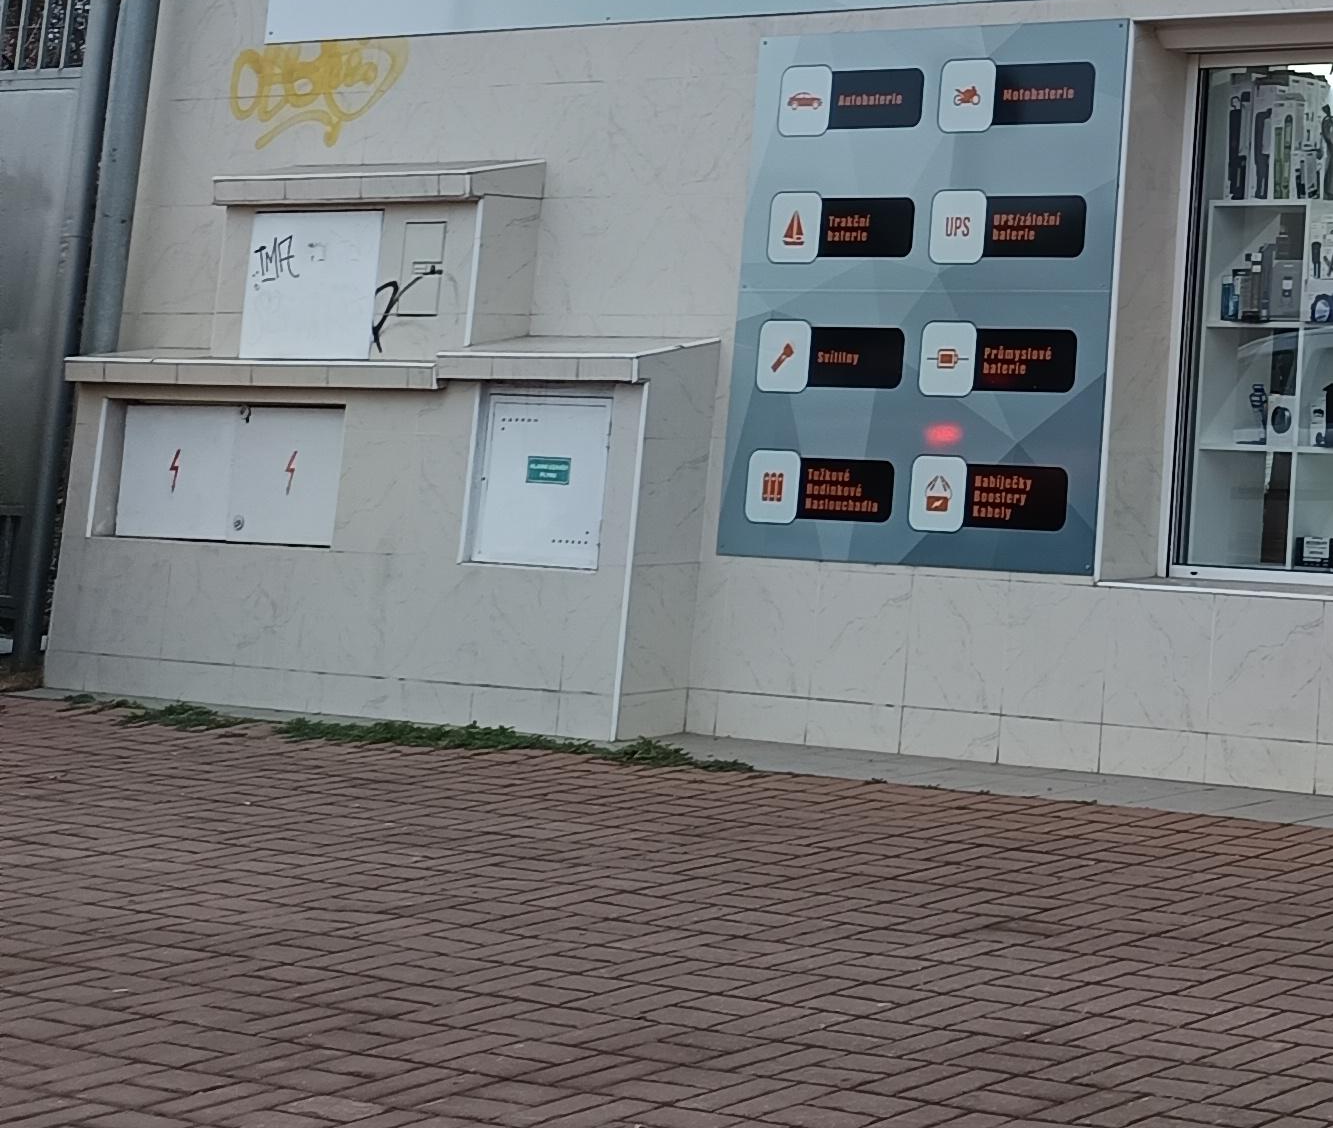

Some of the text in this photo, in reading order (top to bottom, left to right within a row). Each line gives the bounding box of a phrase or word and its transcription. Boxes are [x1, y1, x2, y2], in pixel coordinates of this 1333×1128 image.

[838, 93, 903, 107] Autobaterie
[1003, 86, 1075, 101] Motobaterie
[828, 214, 871, 227] Trakční
[945, 216, 971, 238] UPS
[993, 212, 1061, 227] UPS/záložní
[827, 229, 868, 242] baterie
[992, 229, 1036, 242] baterie
[816, 350, 860, 366] Svítilny
[983, 345, 1053, 361] Průmyslové
[982, 362, 1027, 375] baterie
[807, 469, 851, 482] Tužkové
[974, 474, 1033, 491] Nabíječky
[973, 490, 1027, 506] Boostery
[972, 505, 1012, 521] Kabely
